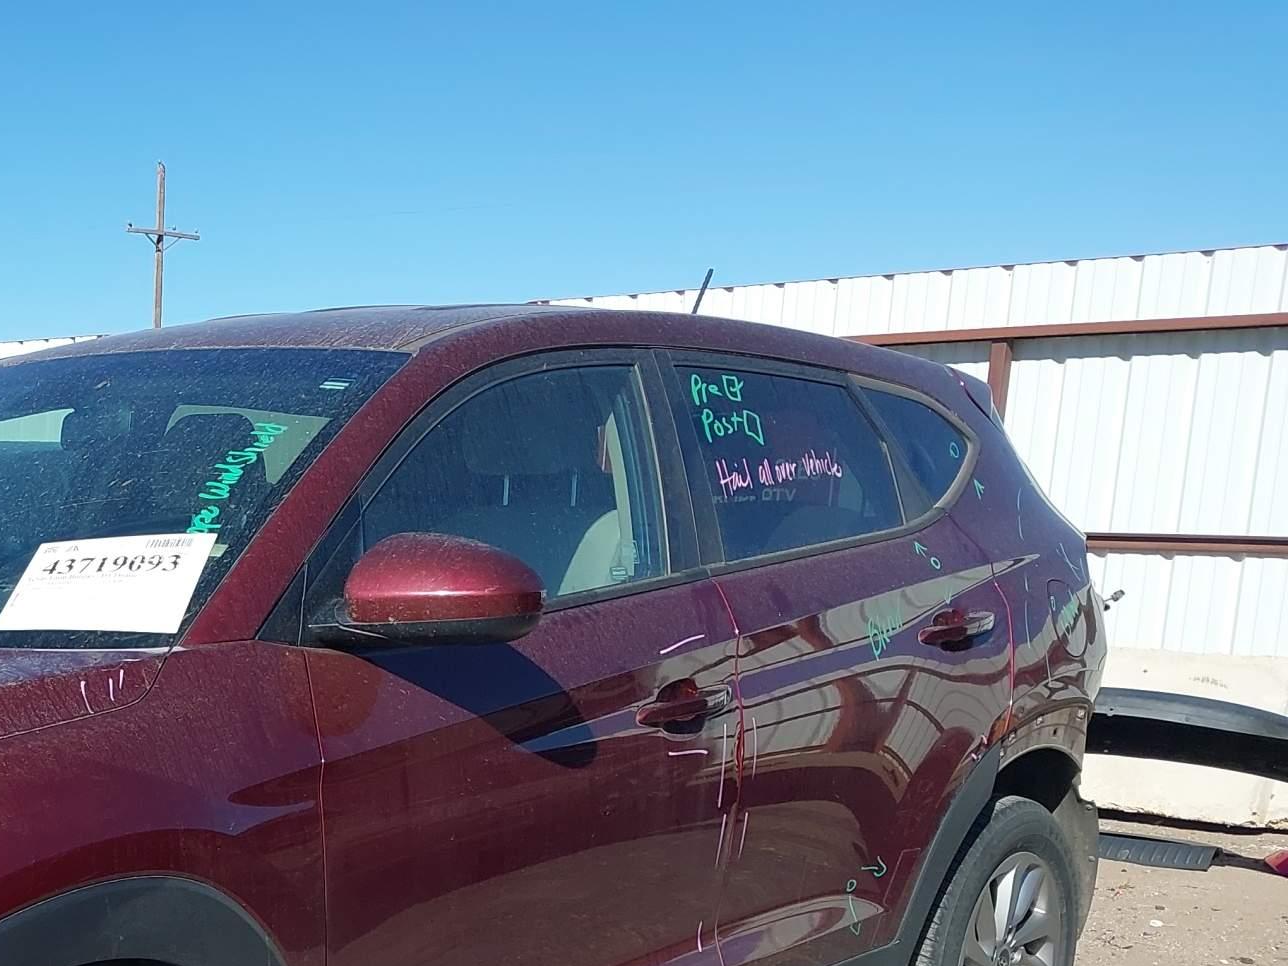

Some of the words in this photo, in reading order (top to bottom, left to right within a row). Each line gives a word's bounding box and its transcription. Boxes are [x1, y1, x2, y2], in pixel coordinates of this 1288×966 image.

[690, 374, 722, 405] Pre
[700, 407, 743, 443] Post
[715, 458, 753, 498] Hail
[758, 457, 774, 486] all
[774, 462, 797, 484] over
[41, 553, 188, 576] 43719093
